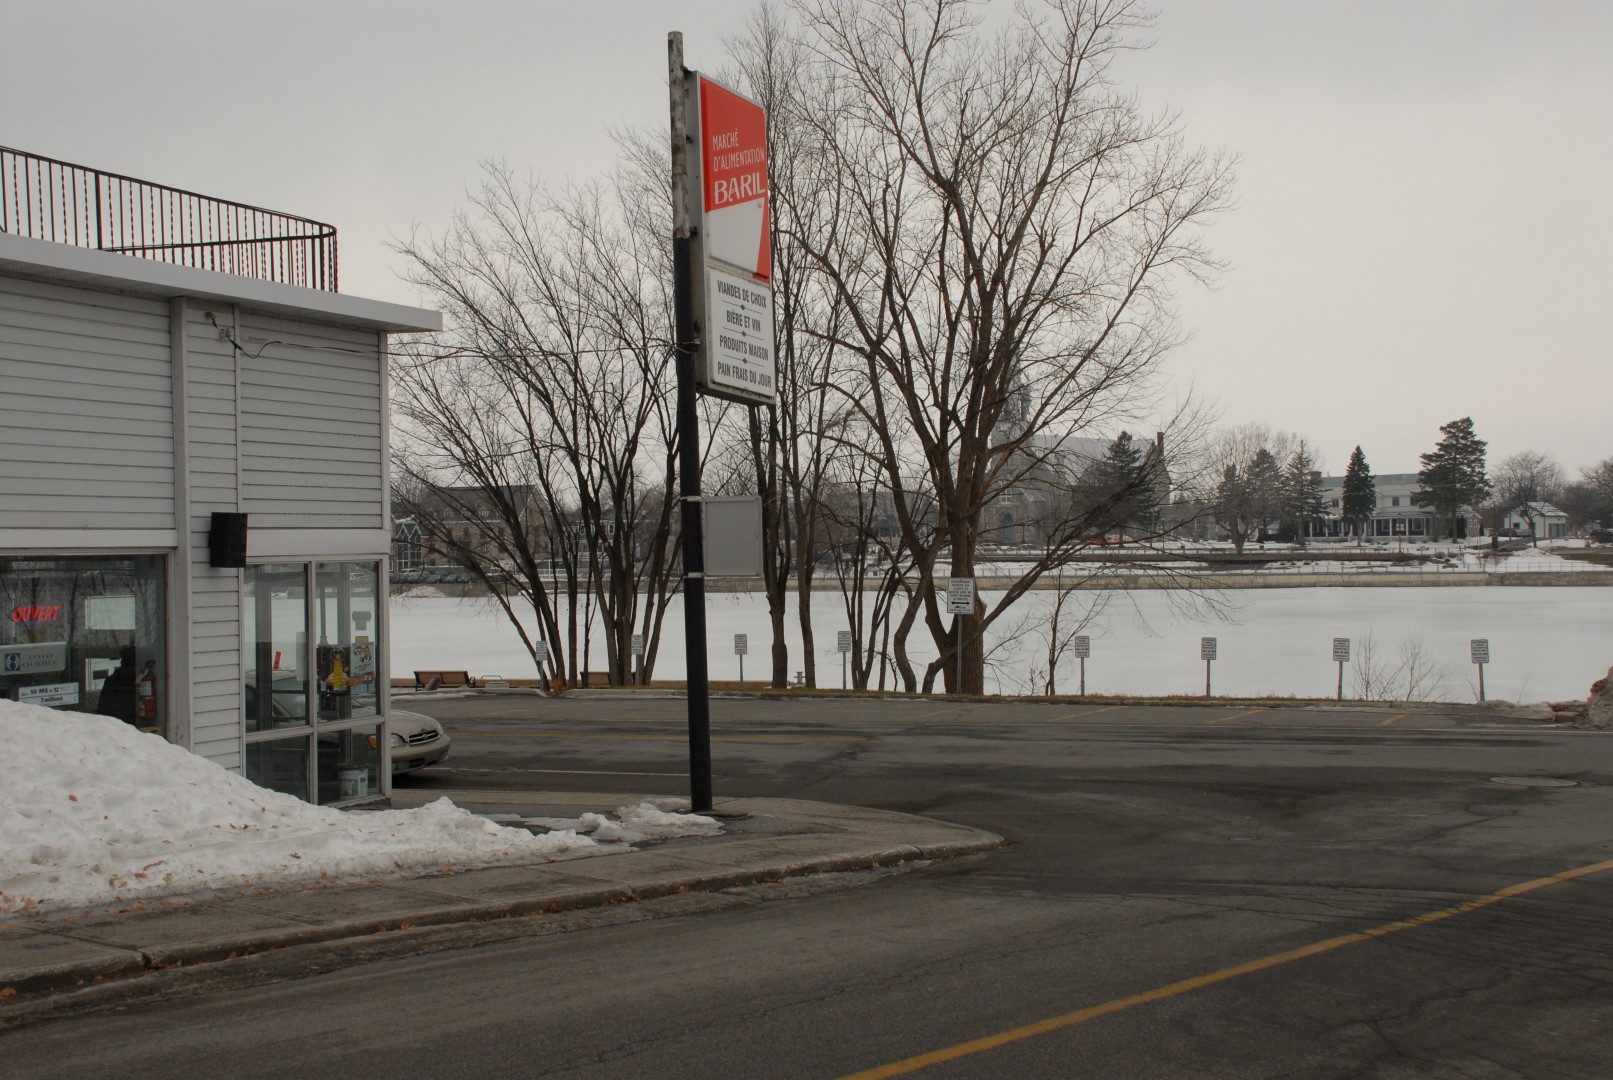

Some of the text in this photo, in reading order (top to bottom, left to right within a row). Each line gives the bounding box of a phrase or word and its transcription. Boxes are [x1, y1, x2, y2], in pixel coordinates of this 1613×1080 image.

[712, 128, 740, 151] MARCHÉ
[713, 147, 765, 172] D'ALIMENTATION
[713, 172, 766, 205] BARIL
[717, 280, 767, 308] VIANDES DE CHOIX
[726, 309, 761, 332] BIÈRE ET VIN
[719, 335, 769, 361] PRODUITS MAISON
[717, 361, 772, 388] PAIN FRAIS DU JOUR
[12, 605, 63, 622] OUVERT
